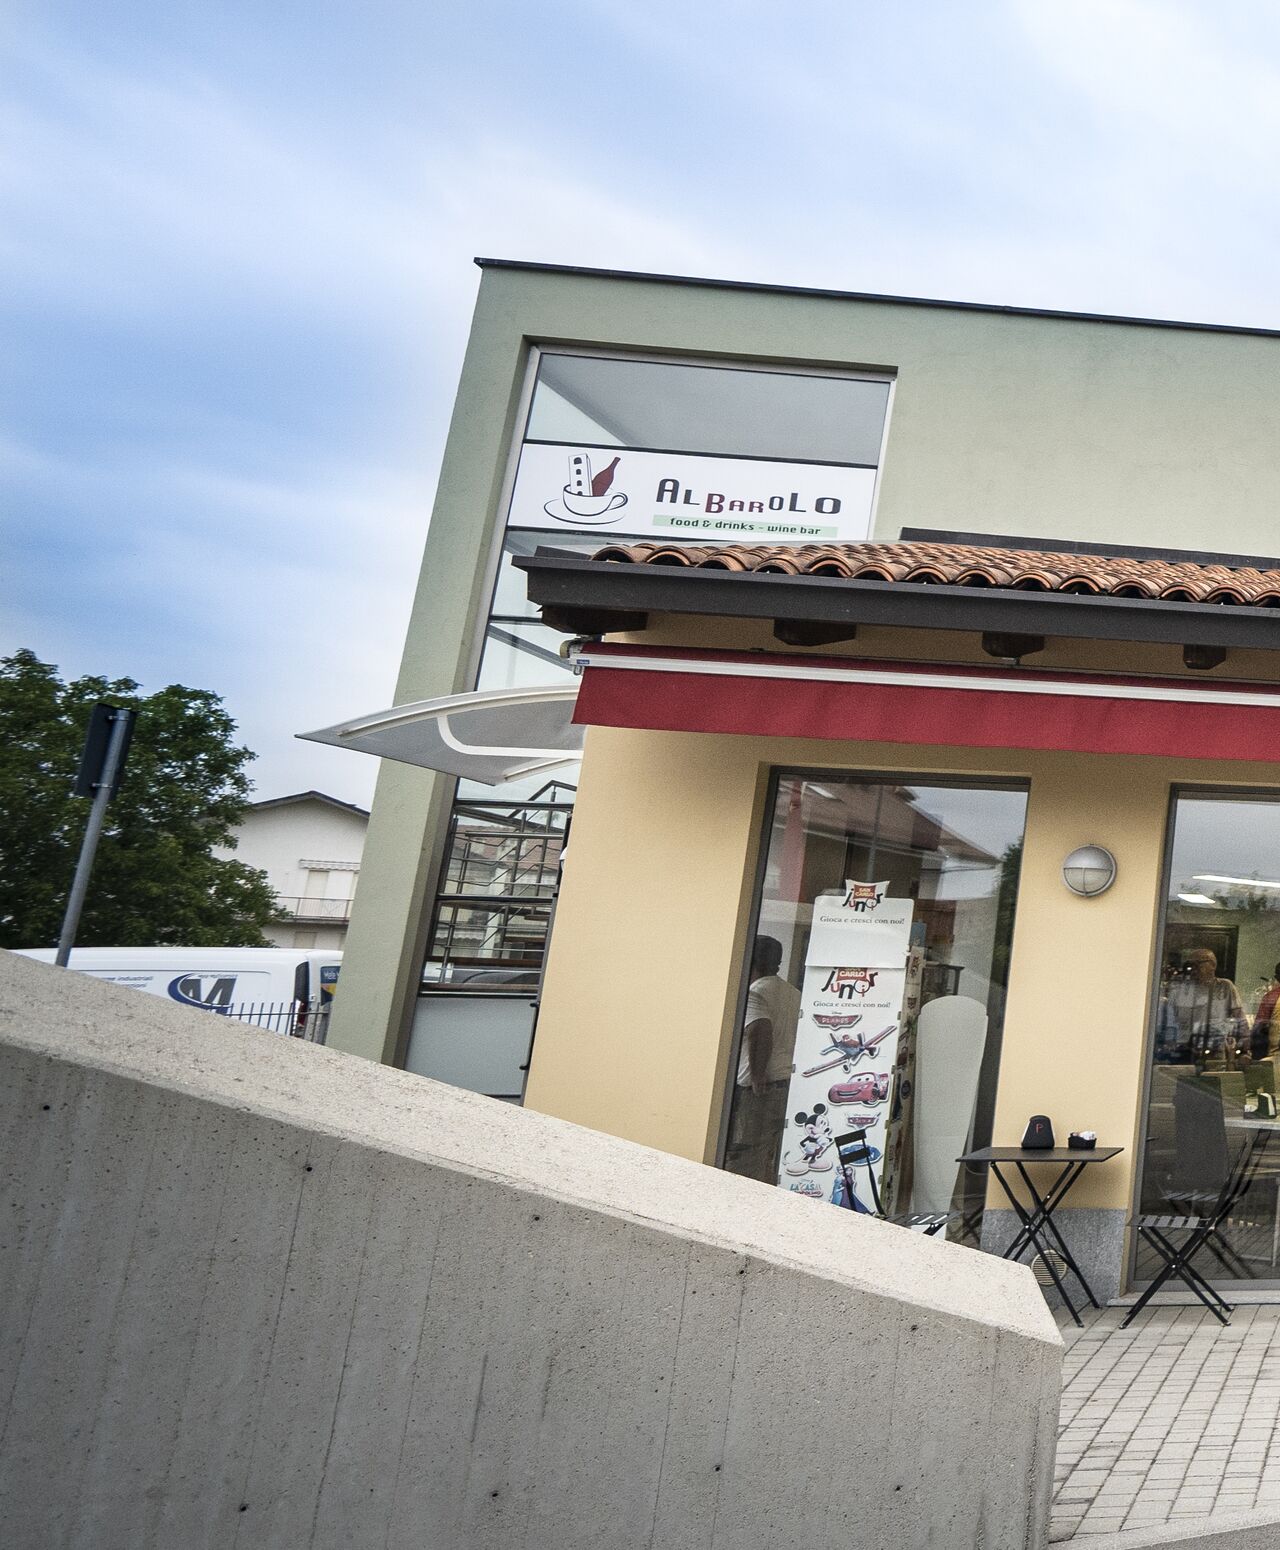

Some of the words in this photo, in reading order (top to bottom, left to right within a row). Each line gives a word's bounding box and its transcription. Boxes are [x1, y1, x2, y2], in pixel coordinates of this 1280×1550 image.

[670, 517, 699, 528] food
[702, 520, 712, 529] &
[715, 521, 755, 532] drinks
[767, 525, 797, 534] wine
[800, 527, 821, 535] bar
